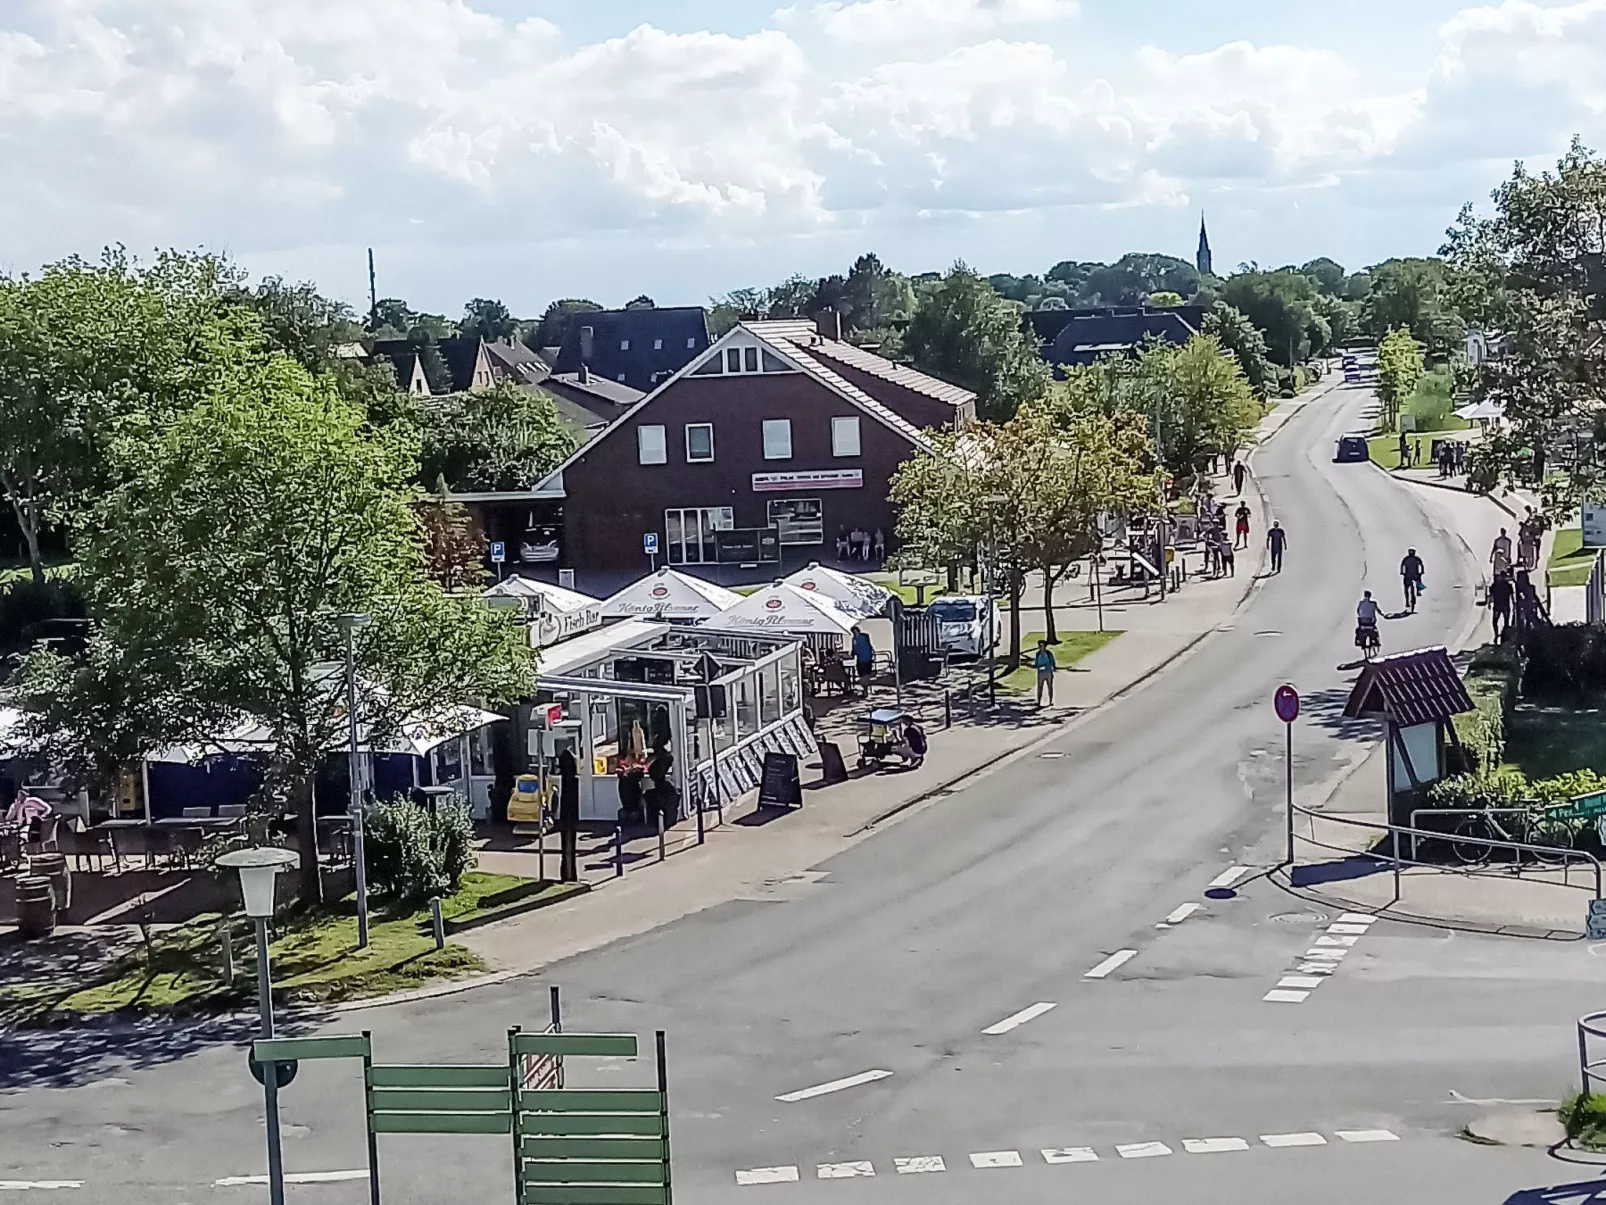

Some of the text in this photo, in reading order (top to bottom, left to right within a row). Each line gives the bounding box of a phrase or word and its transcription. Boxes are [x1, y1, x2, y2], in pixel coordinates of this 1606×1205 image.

[618, 602, 653, 613] König
[564, 609, 600, 632] Fisch Bar
